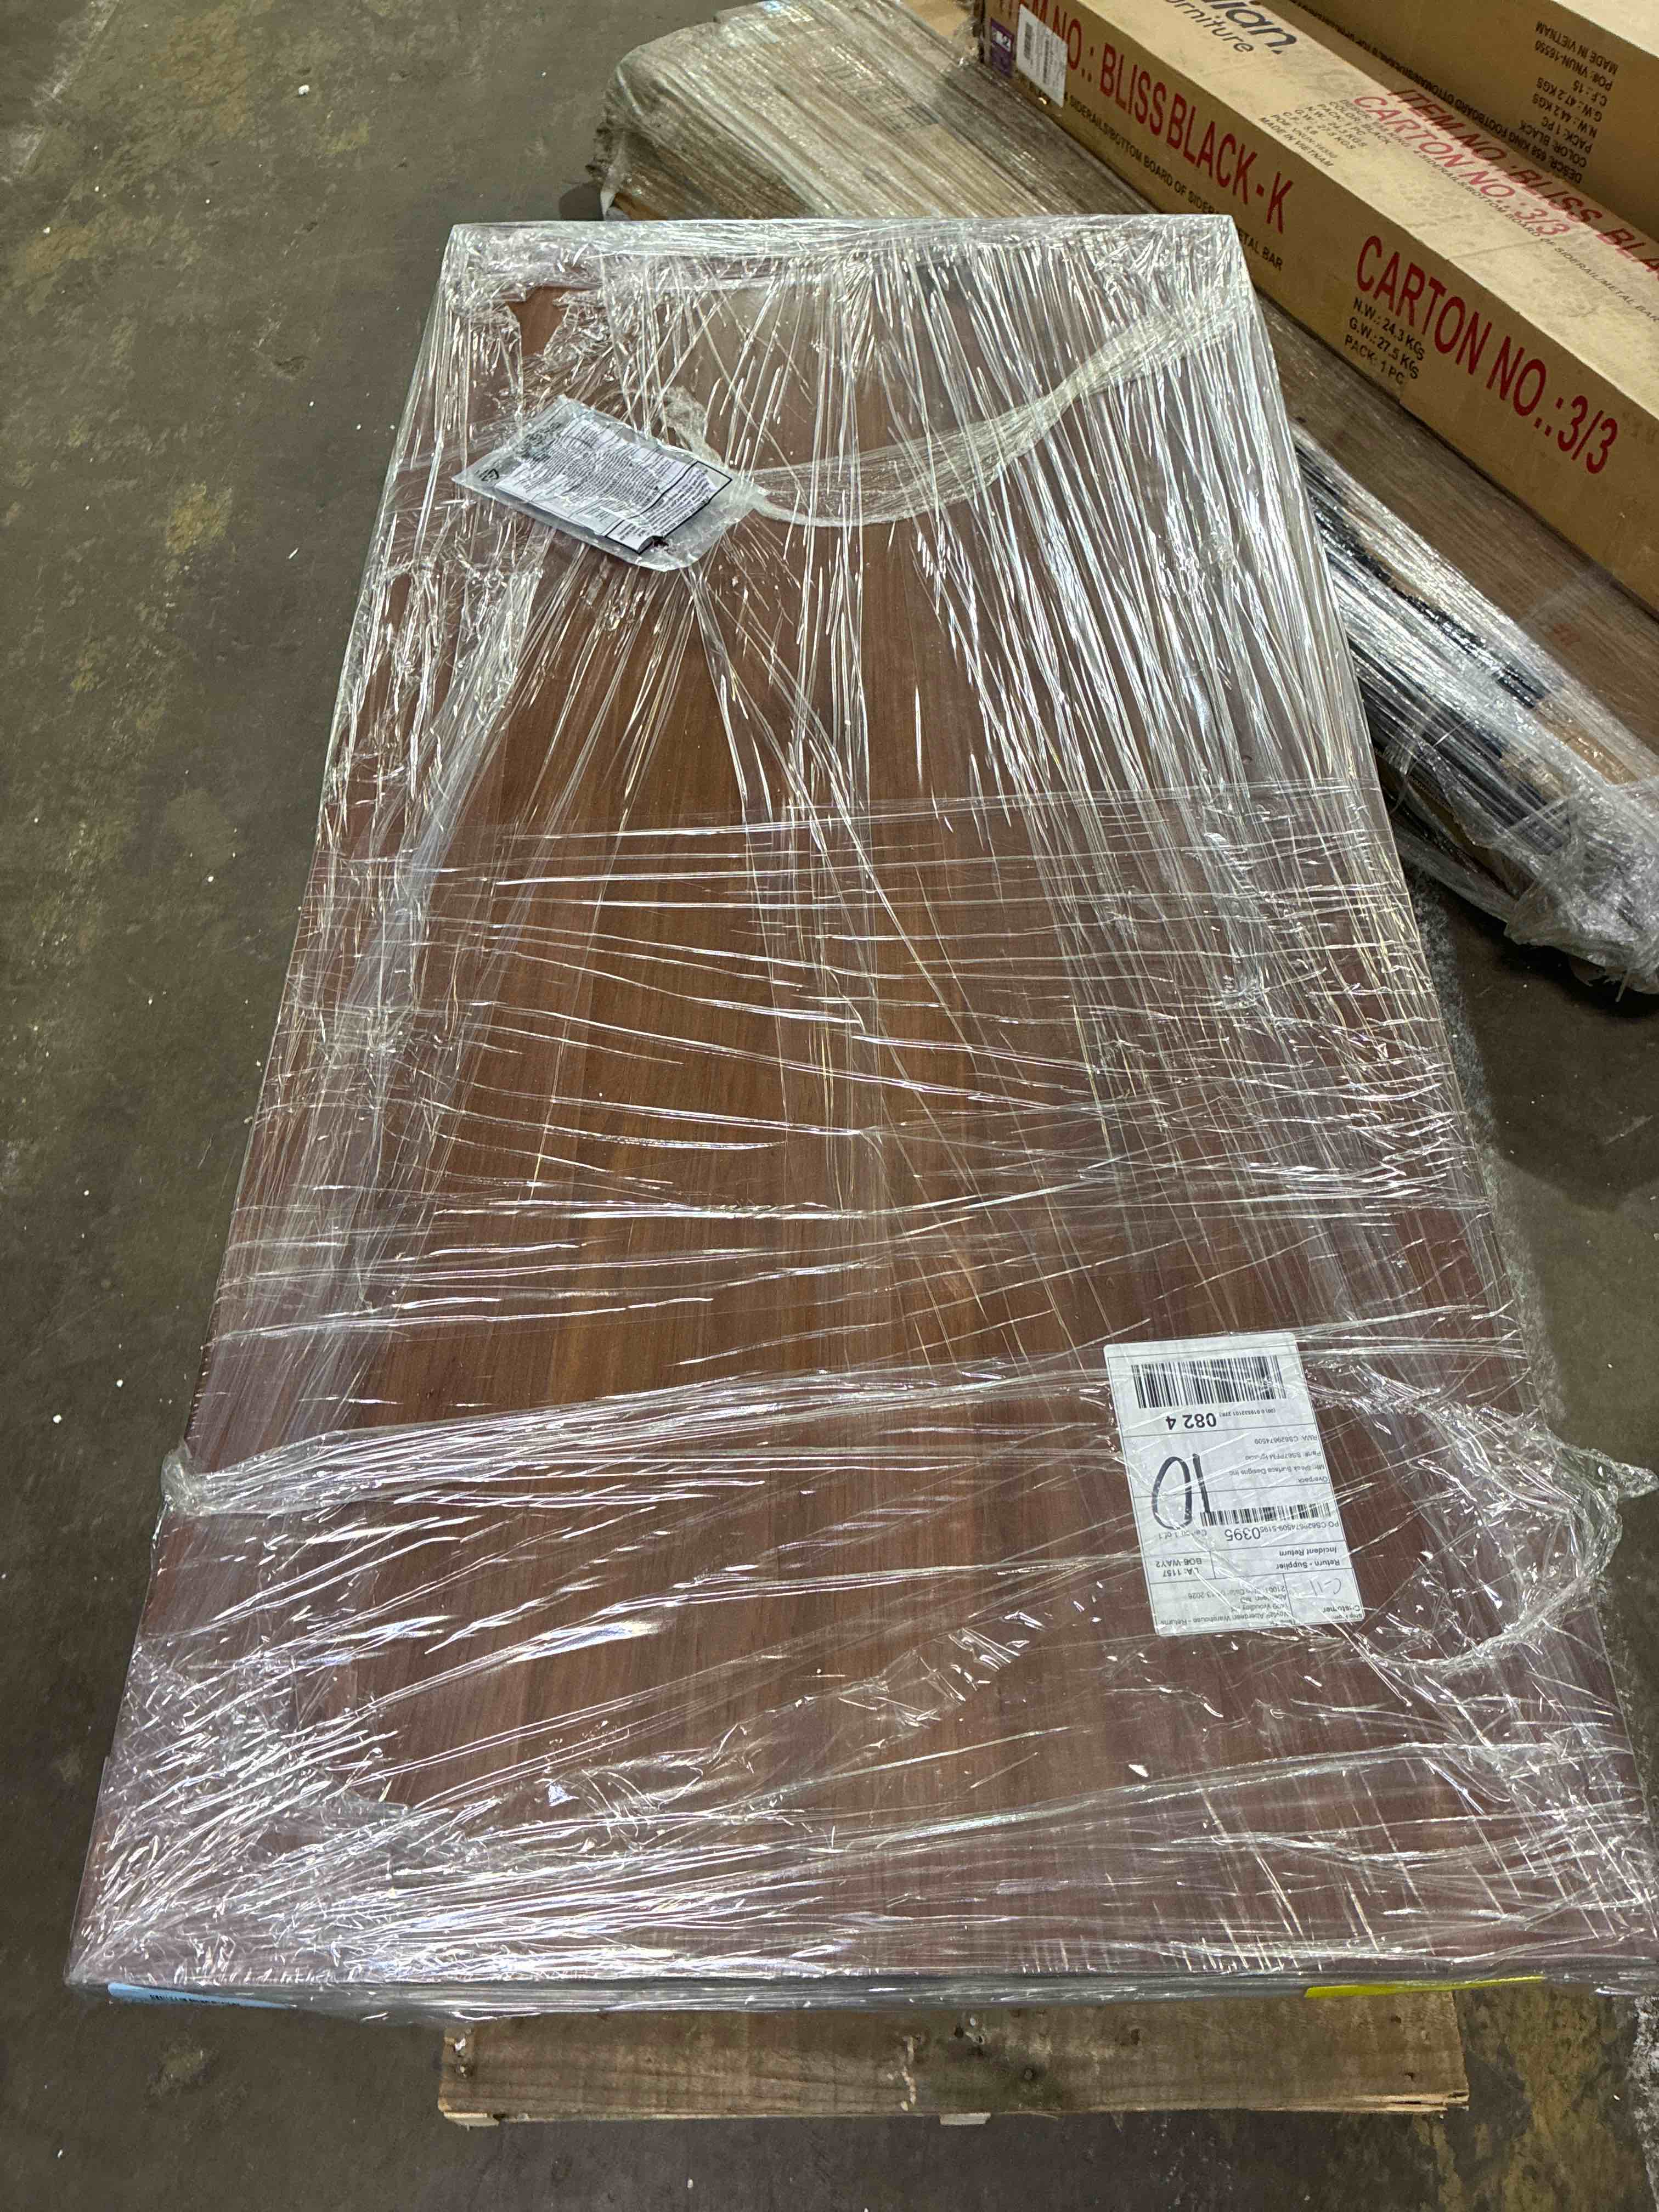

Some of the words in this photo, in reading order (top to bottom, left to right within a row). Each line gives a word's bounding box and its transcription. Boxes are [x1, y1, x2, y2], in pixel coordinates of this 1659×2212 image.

[1536, 20, 1576, 53] VIETNAM
[1577, 45, 1590, 59] IN
[1589, 50, 1618, 75] MADE
[1536, 77, 1559, 97] KGS
[1532, 93, 1553, 111] KGS
[1353, 96, 1475, 168] CARTON
[1519, 120, 1551, 146] BLACK
[1541, 116, 1555, 131] PC
[1144, 155, 1172, 187] BOARD
[1175, 180, 1187, 196] OF
[1262, 246, 1283, 270] BAR
[1357, 235, 1492, 375] CARTON
[1353, 297, 1381, 325] N.W.:
[1383, 318, 1404, 342] 24.3
[1406, 334, 1425, 361] KGS
[1350, 317, 1377, 345] G.W.:
[1377, 336, 1400, 360] 27.5
[1400, 354, 1419, 379] KGS
[1380, 361, 1386, 373] 1
[1387, 366, 1405, 385] PC
[1164, 1415, 1178, 1430] 4
[1181, 1412, 1217, 1429] 082
[1278, 1549, 1305, 1557] Return
[1305, 1546, 1338, 1555] Incident
[1161, 1568, 1181, 1577] 1157
[1274, 1560, 1308, 1570] Supplier
[1313, 1559, 1340, 1567] Return
